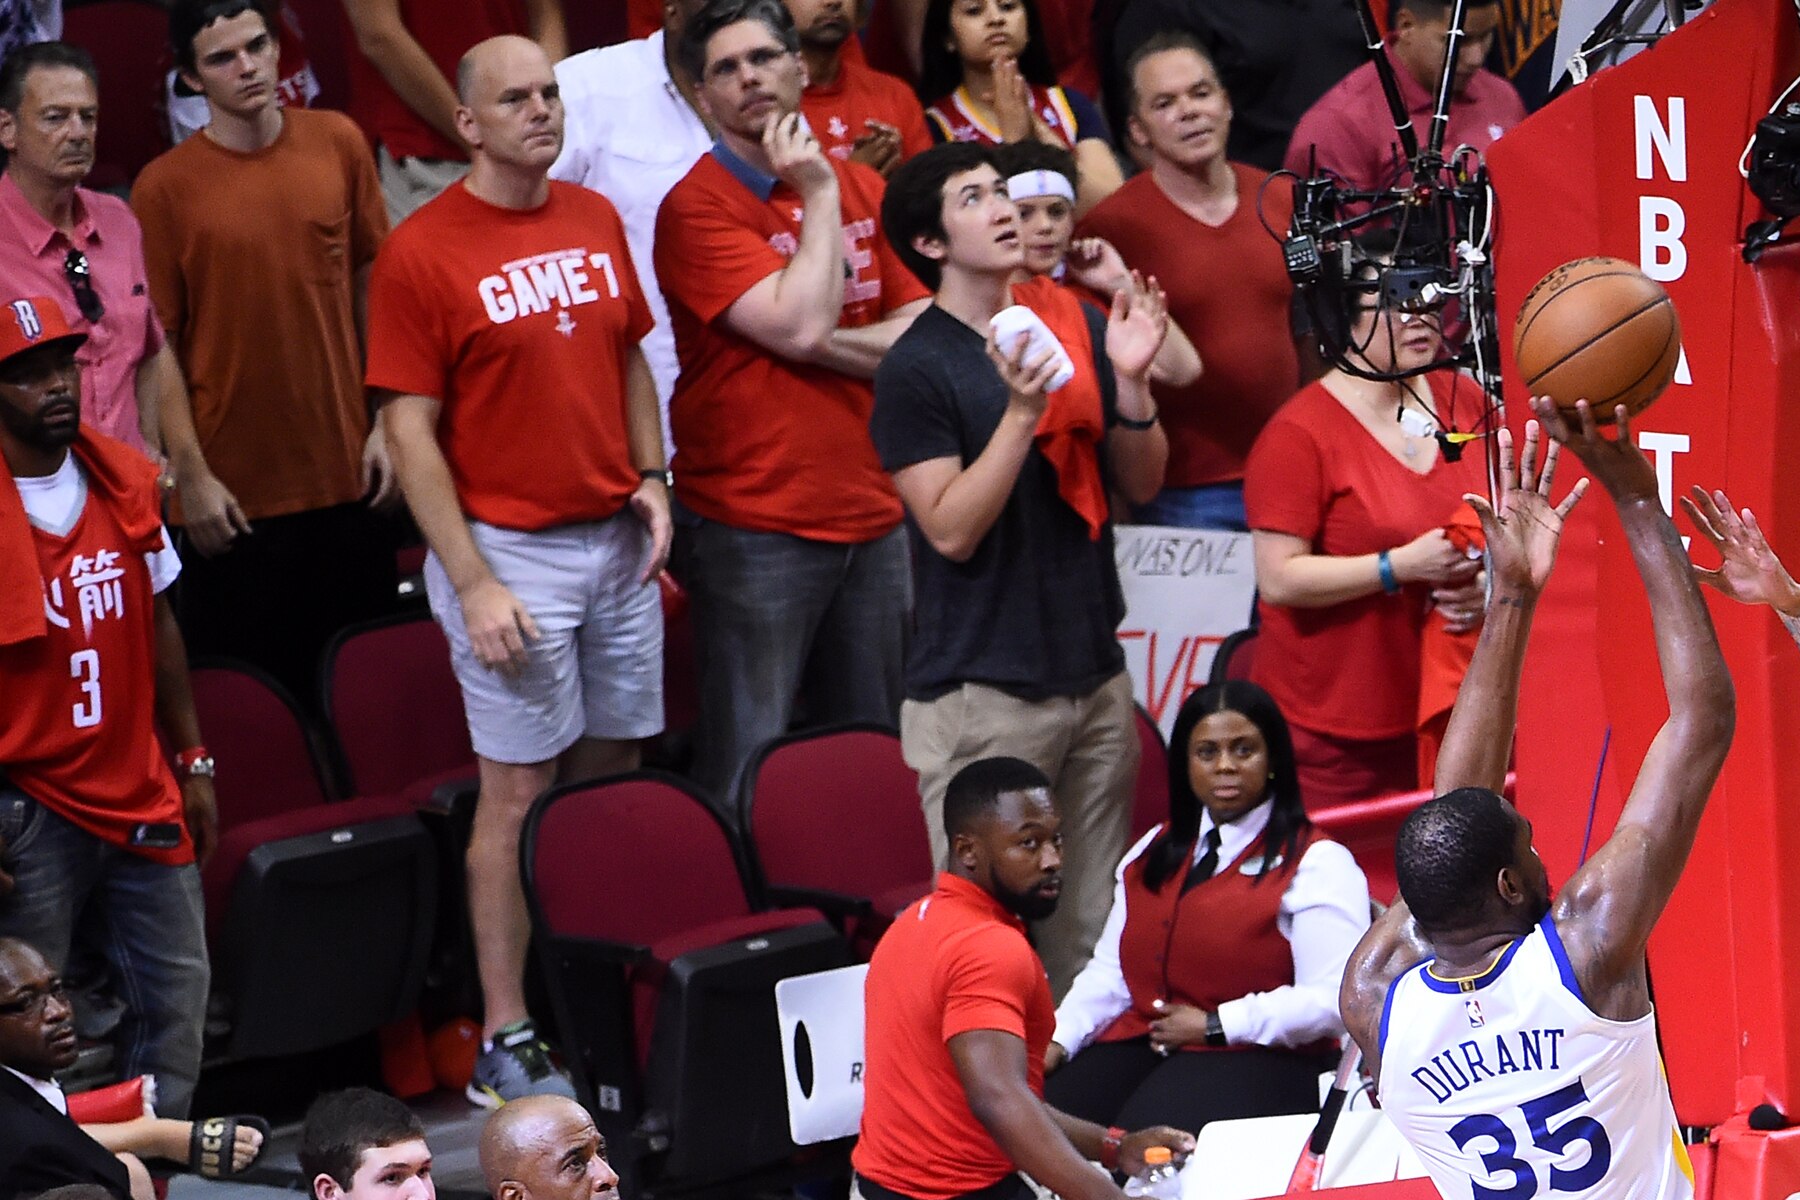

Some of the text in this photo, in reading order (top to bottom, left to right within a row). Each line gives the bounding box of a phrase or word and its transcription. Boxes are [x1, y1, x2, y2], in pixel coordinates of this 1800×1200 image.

[11, 298, 43, 339] R
[478, 257, 599, 325] GAME
[588, 252, 620, 299] 7
[70, 648, 103, 728] 3
[1410, 1028, 1565, 1104] DURANT
